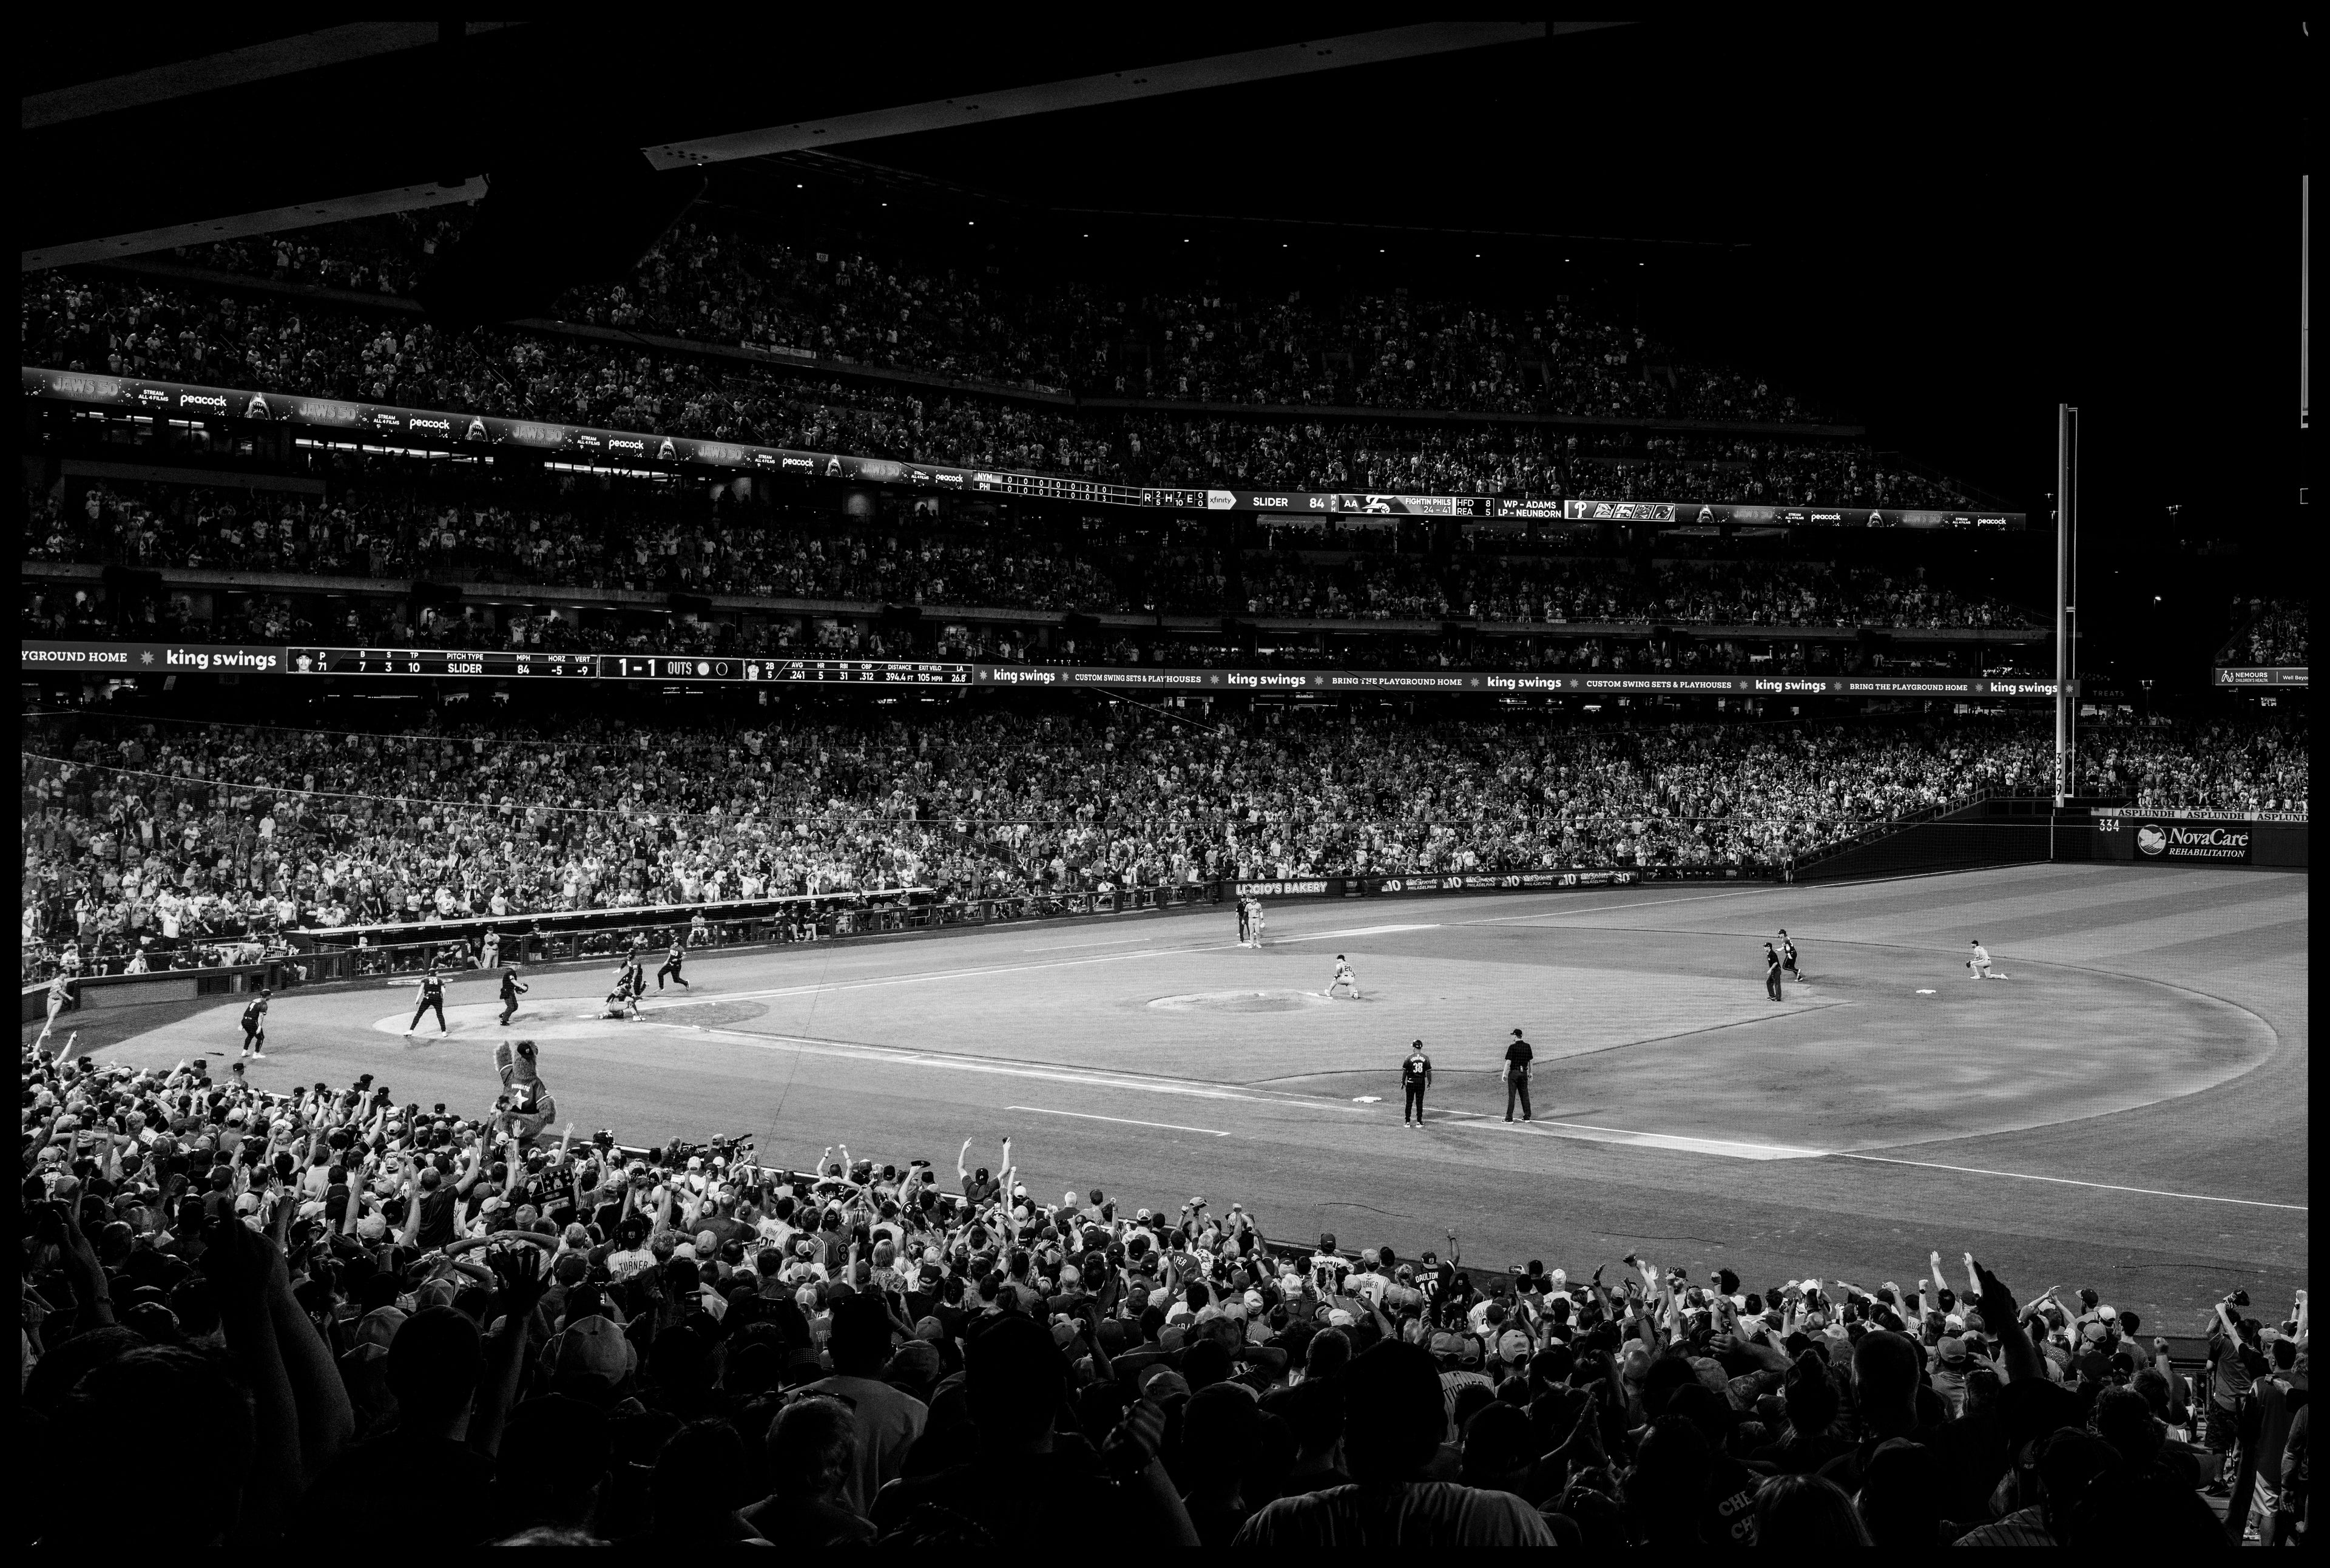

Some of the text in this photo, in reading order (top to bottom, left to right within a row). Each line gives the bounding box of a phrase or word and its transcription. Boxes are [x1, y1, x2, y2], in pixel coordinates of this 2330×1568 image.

[52, 376, 120, 396] JAWS 50
[181, 395, 226, 406] peacock
[299, 402, 357, 421] JAWS 50
[410, 419, 450, 429] peacock
[609, 440, 643, 450] peacock
[783, 458, 813, 467] peacock
[978, 473, 993, 481] NYM
[979, 482, 991, 491] PHI
[1254, 497, 1324, 508] SLIDER 84
[1516, 509, 1561, 518] NEUNBORN
[1811, 513, 1840, 522] peacock
[1978, 518, 2006, 526] peacock
[95, 652, 133, 663] HOME
[167, 649, 276, 670] king swings
[318, 662, 326, 671] 71
[360, 661, 587, 675] 7 3 10 SLIDER 84 -5 -9
[620, 658, 655, 676] 1 1
[668, 661, 692, 675] OUTS
[790, 671, 805, 679] .241
[819, 671, 823, 680] 5
[994, 669, 1055, 684] king swings
[1228, 673, 1305, 687] king swings
[1488, 676, 1561, 690] king swings
[1756, 679, 1826, 692] king swings
[1991, 682, 2058, 695] king swings
[2099, 819, 2119, 831] 334
[2168, 828, 2249, 846] NovaCare
[2169, 848, 2245, 857] REHABILITATION
[1447, 877, 1462, 888] 10
[1507, 875, 1520, 886] 10
[1564, 873, 1576, 885] 10
[1284, 881, 1328, 894] BAKERY
[1389, 880, 1401, 891] 10
[1413, 1063, 1423, 1073] 38
[512, 1084, 530, 1093] PHANATIC
[618, 1260, 648, 1272] TURNER
[1414, 1271, 1439, 1283] DAULTON
[1419, 1279, 1439, 1302] 10
